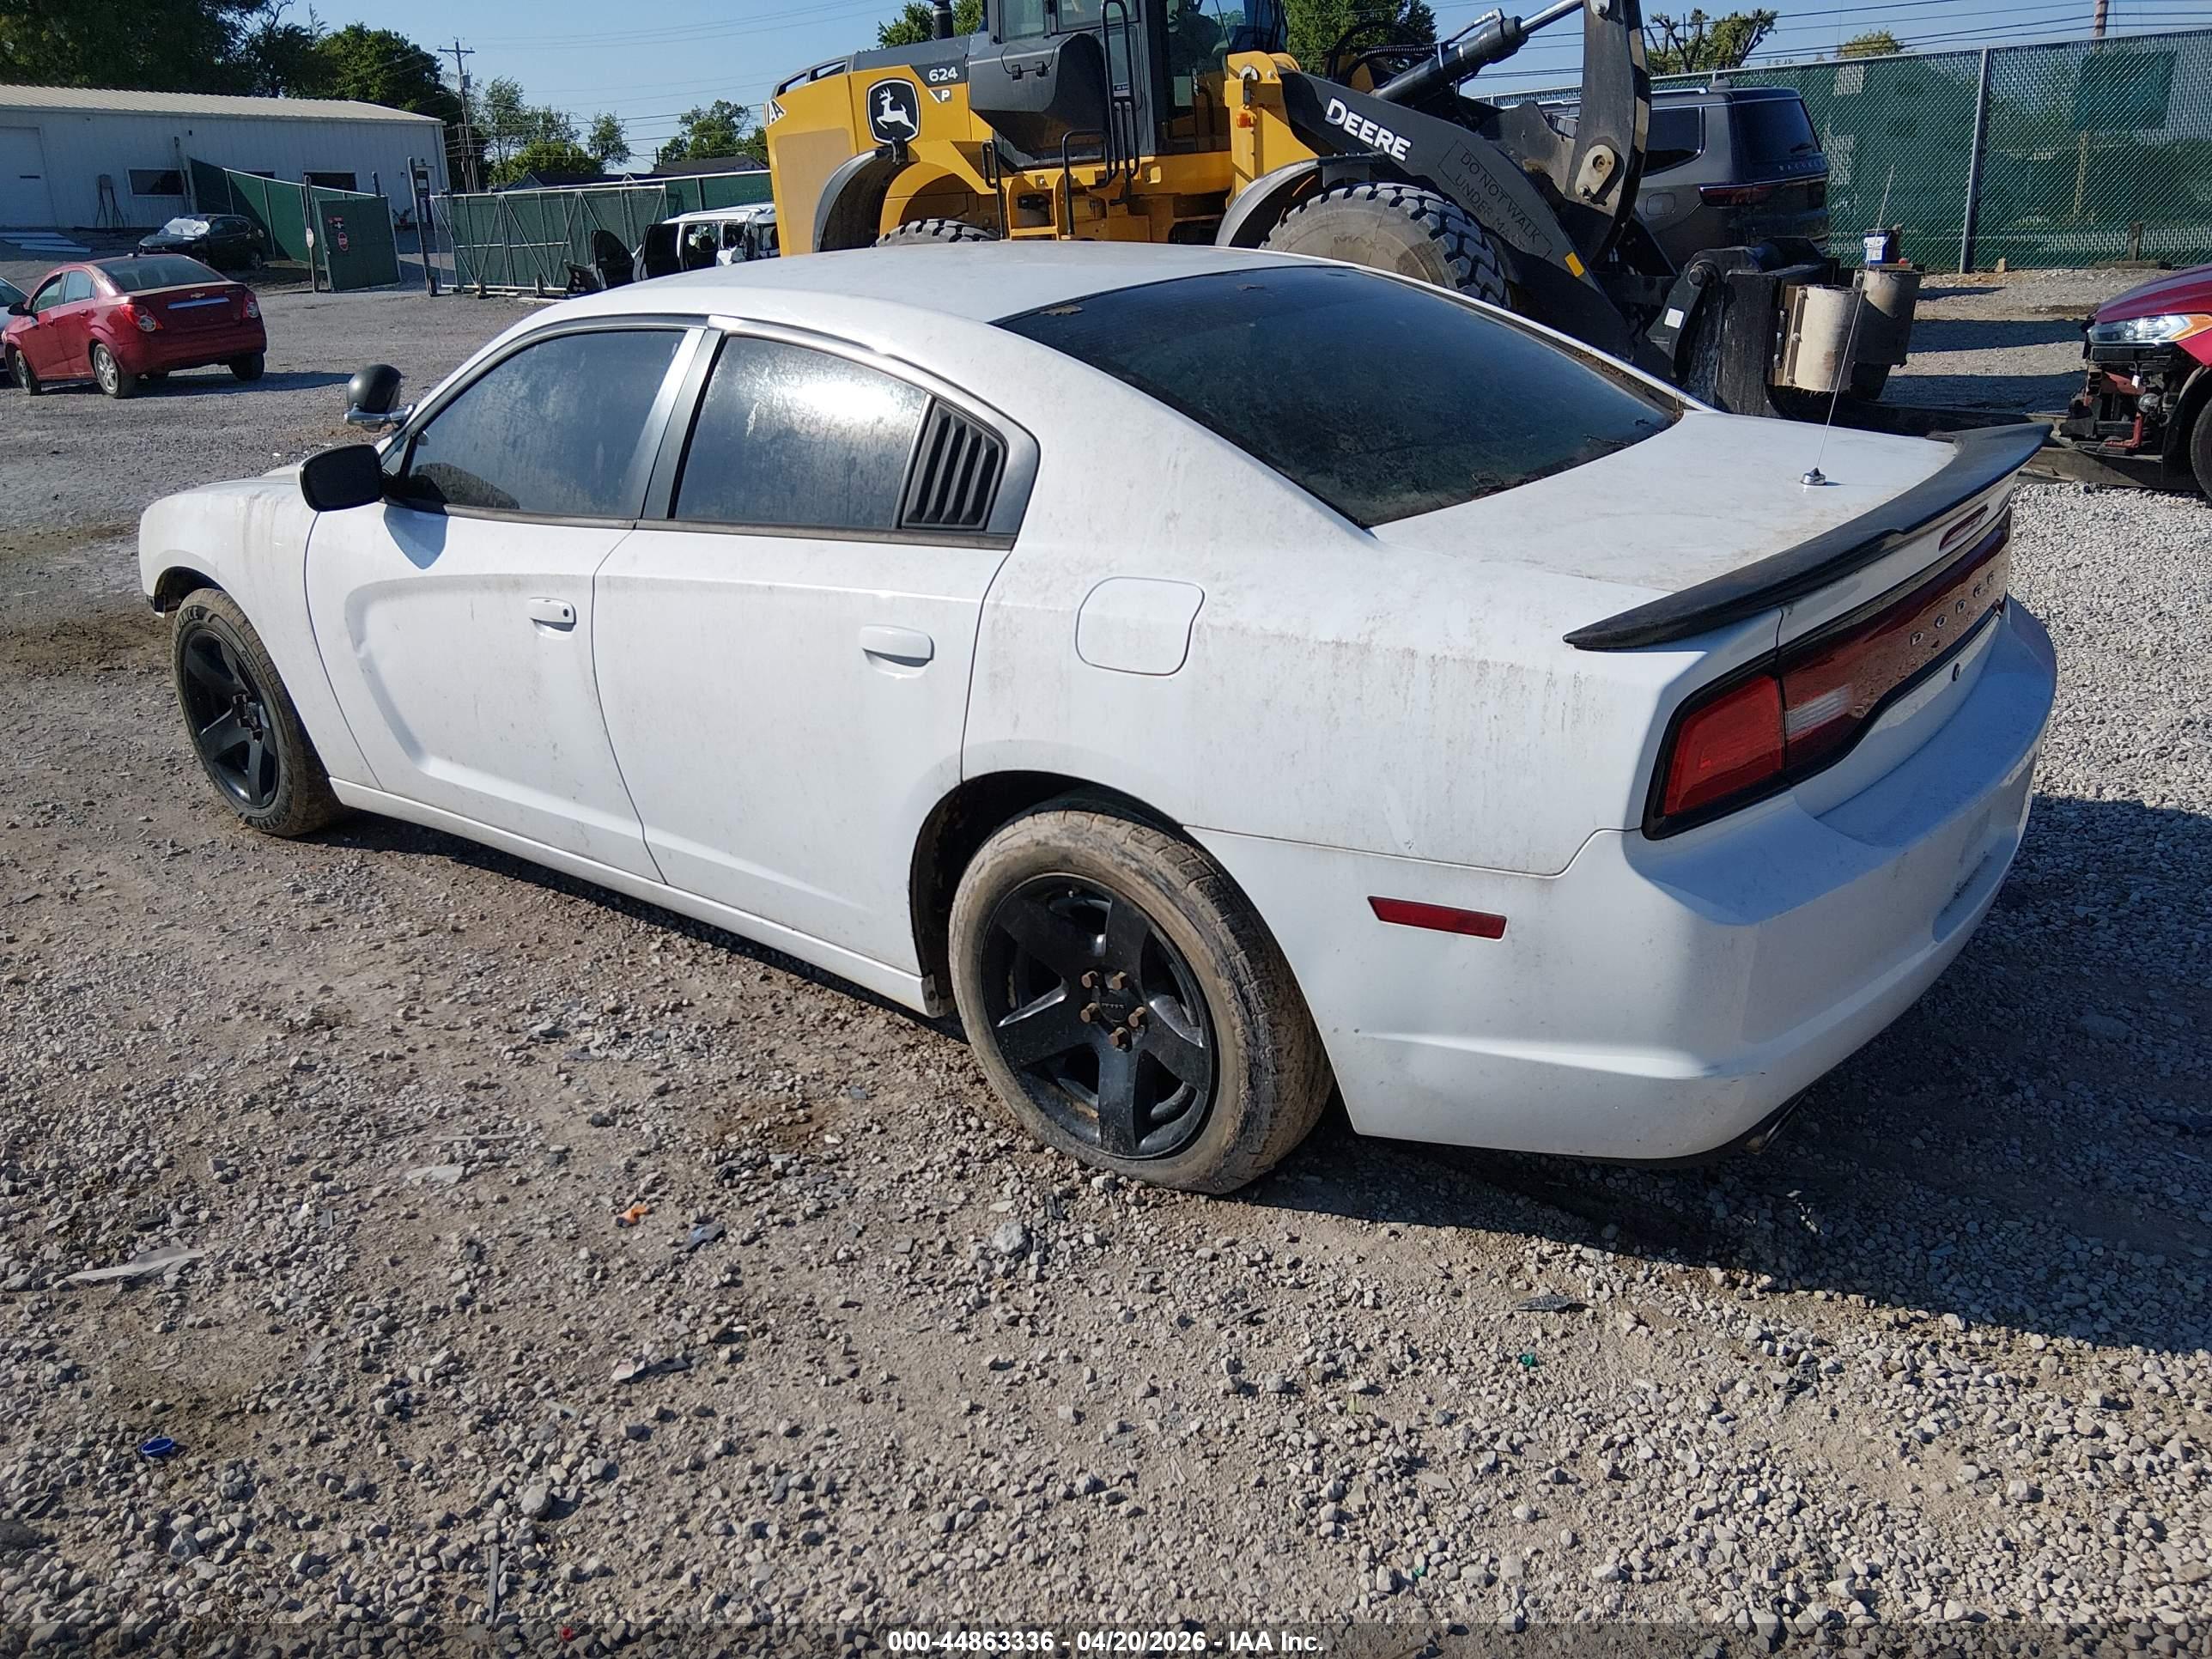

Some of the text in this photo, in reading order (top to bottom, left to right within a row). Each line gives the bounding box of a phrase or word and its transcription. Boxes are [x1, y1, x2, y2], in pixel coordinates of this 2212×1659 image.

[928, 66, 958, 82] 624
[941, 89, 951, 102] P
[1324, 97, 1412, 162] DEERE
[1455, 173, 1493, 216] UNDER
[1460, 152, 1540, 244] DO NOT WALK
